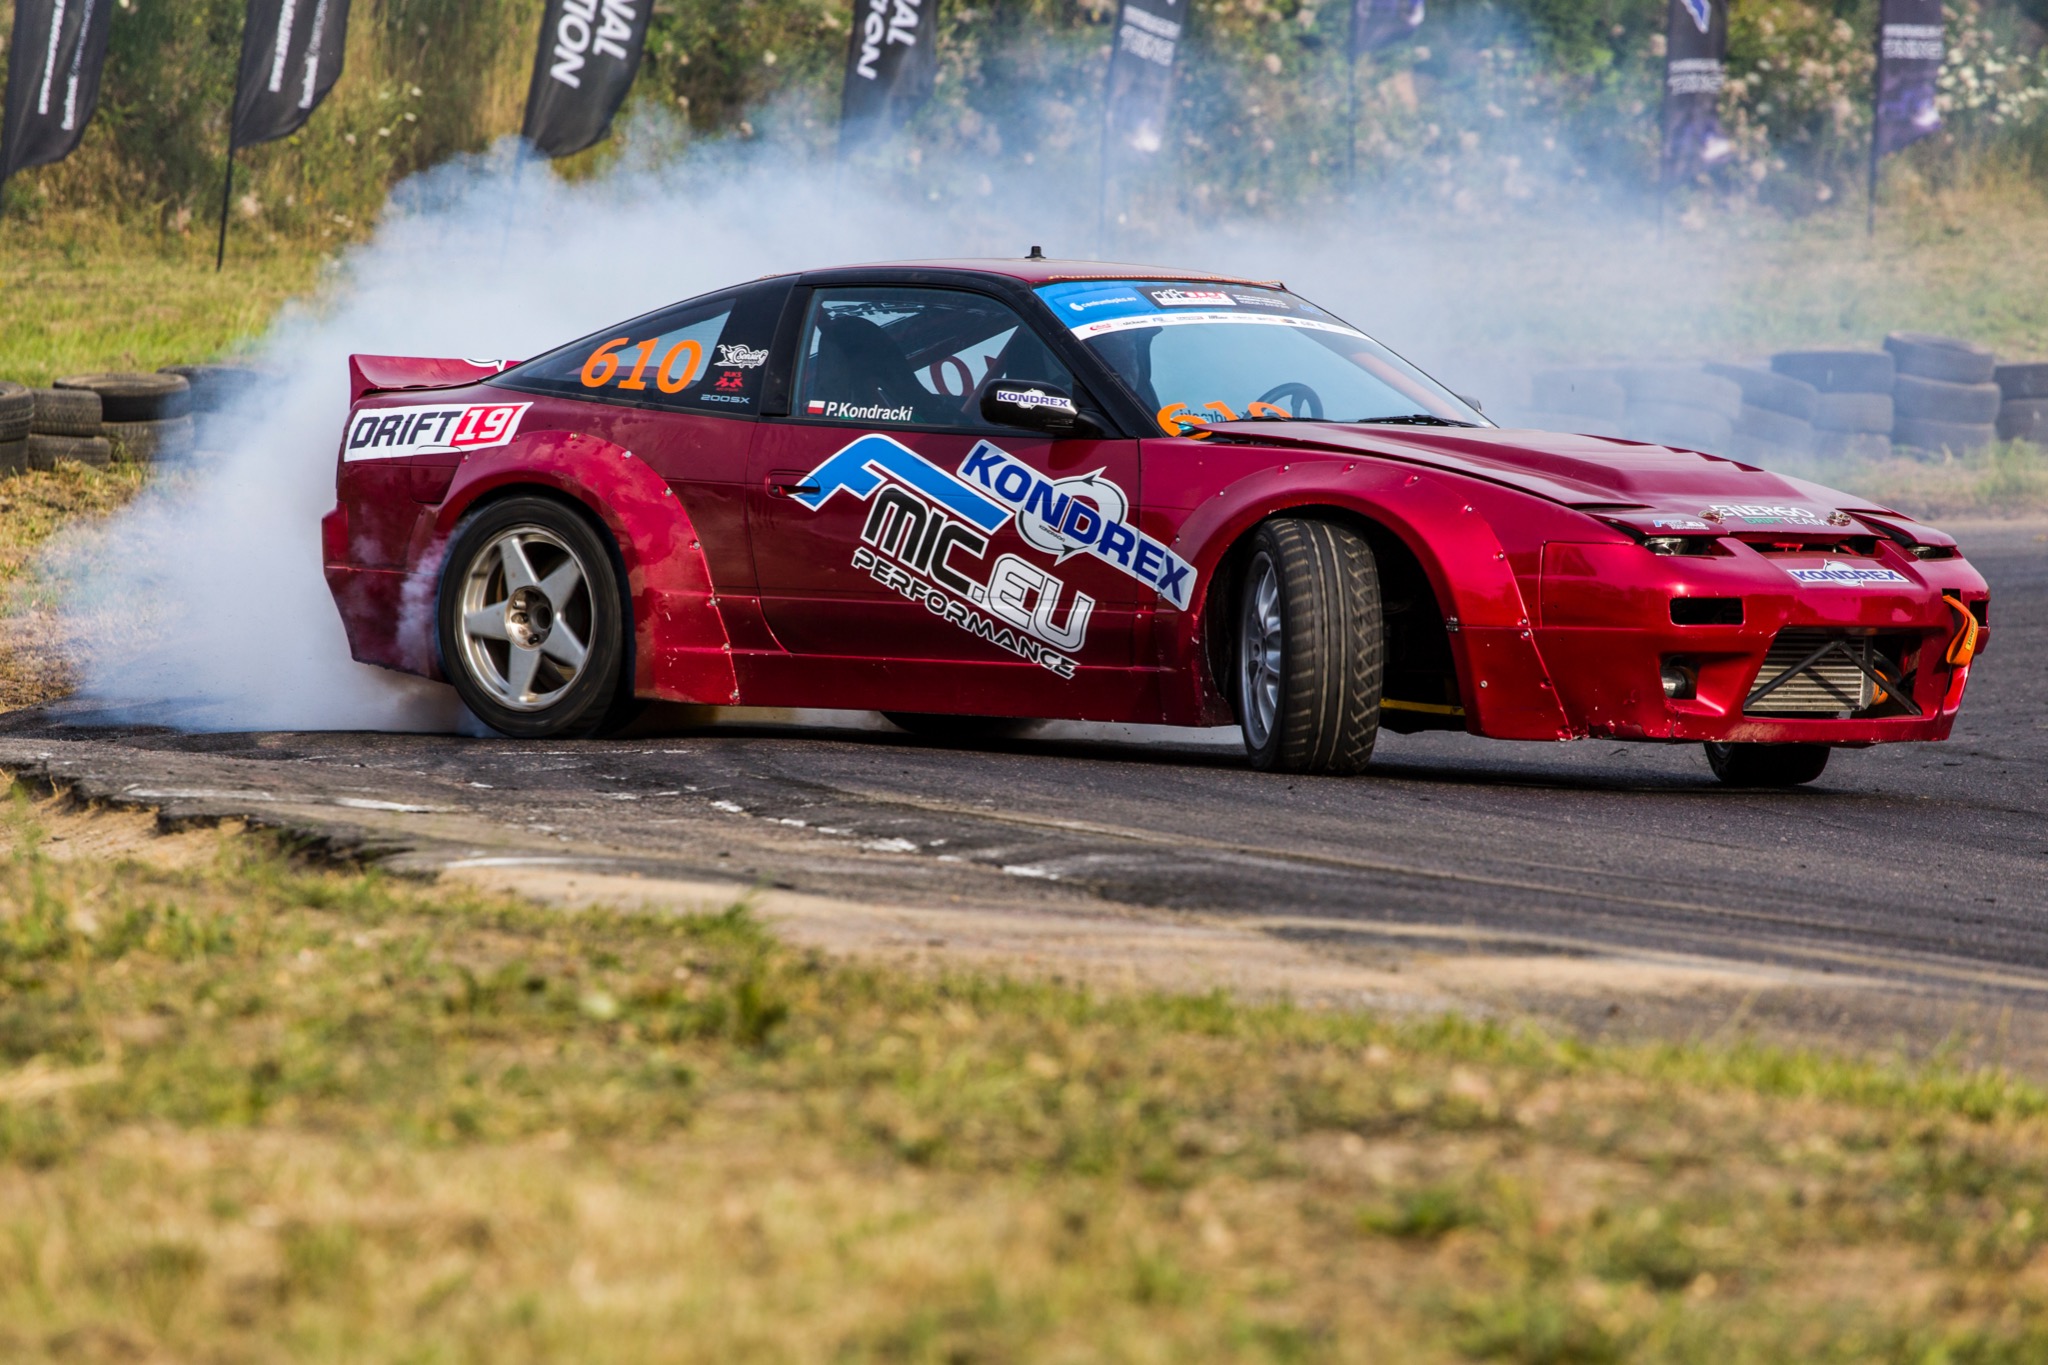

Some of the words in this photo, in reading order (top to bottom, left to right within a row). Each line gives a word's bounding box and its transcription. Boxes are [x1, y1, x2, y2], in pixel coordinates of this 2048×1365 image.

[581, 337, 703, 394] 610
[700, 394, 750, 404] 200SX
[998, 391, 1068, 407] KONDREX
[826, 402, 913, 422] P.Kondracki
[963, 445, 1189, 603] KONDREX
[1792, 569, 1903, 581] KONDREX
[853, 548, 1079, 679] PERFORMANCE
